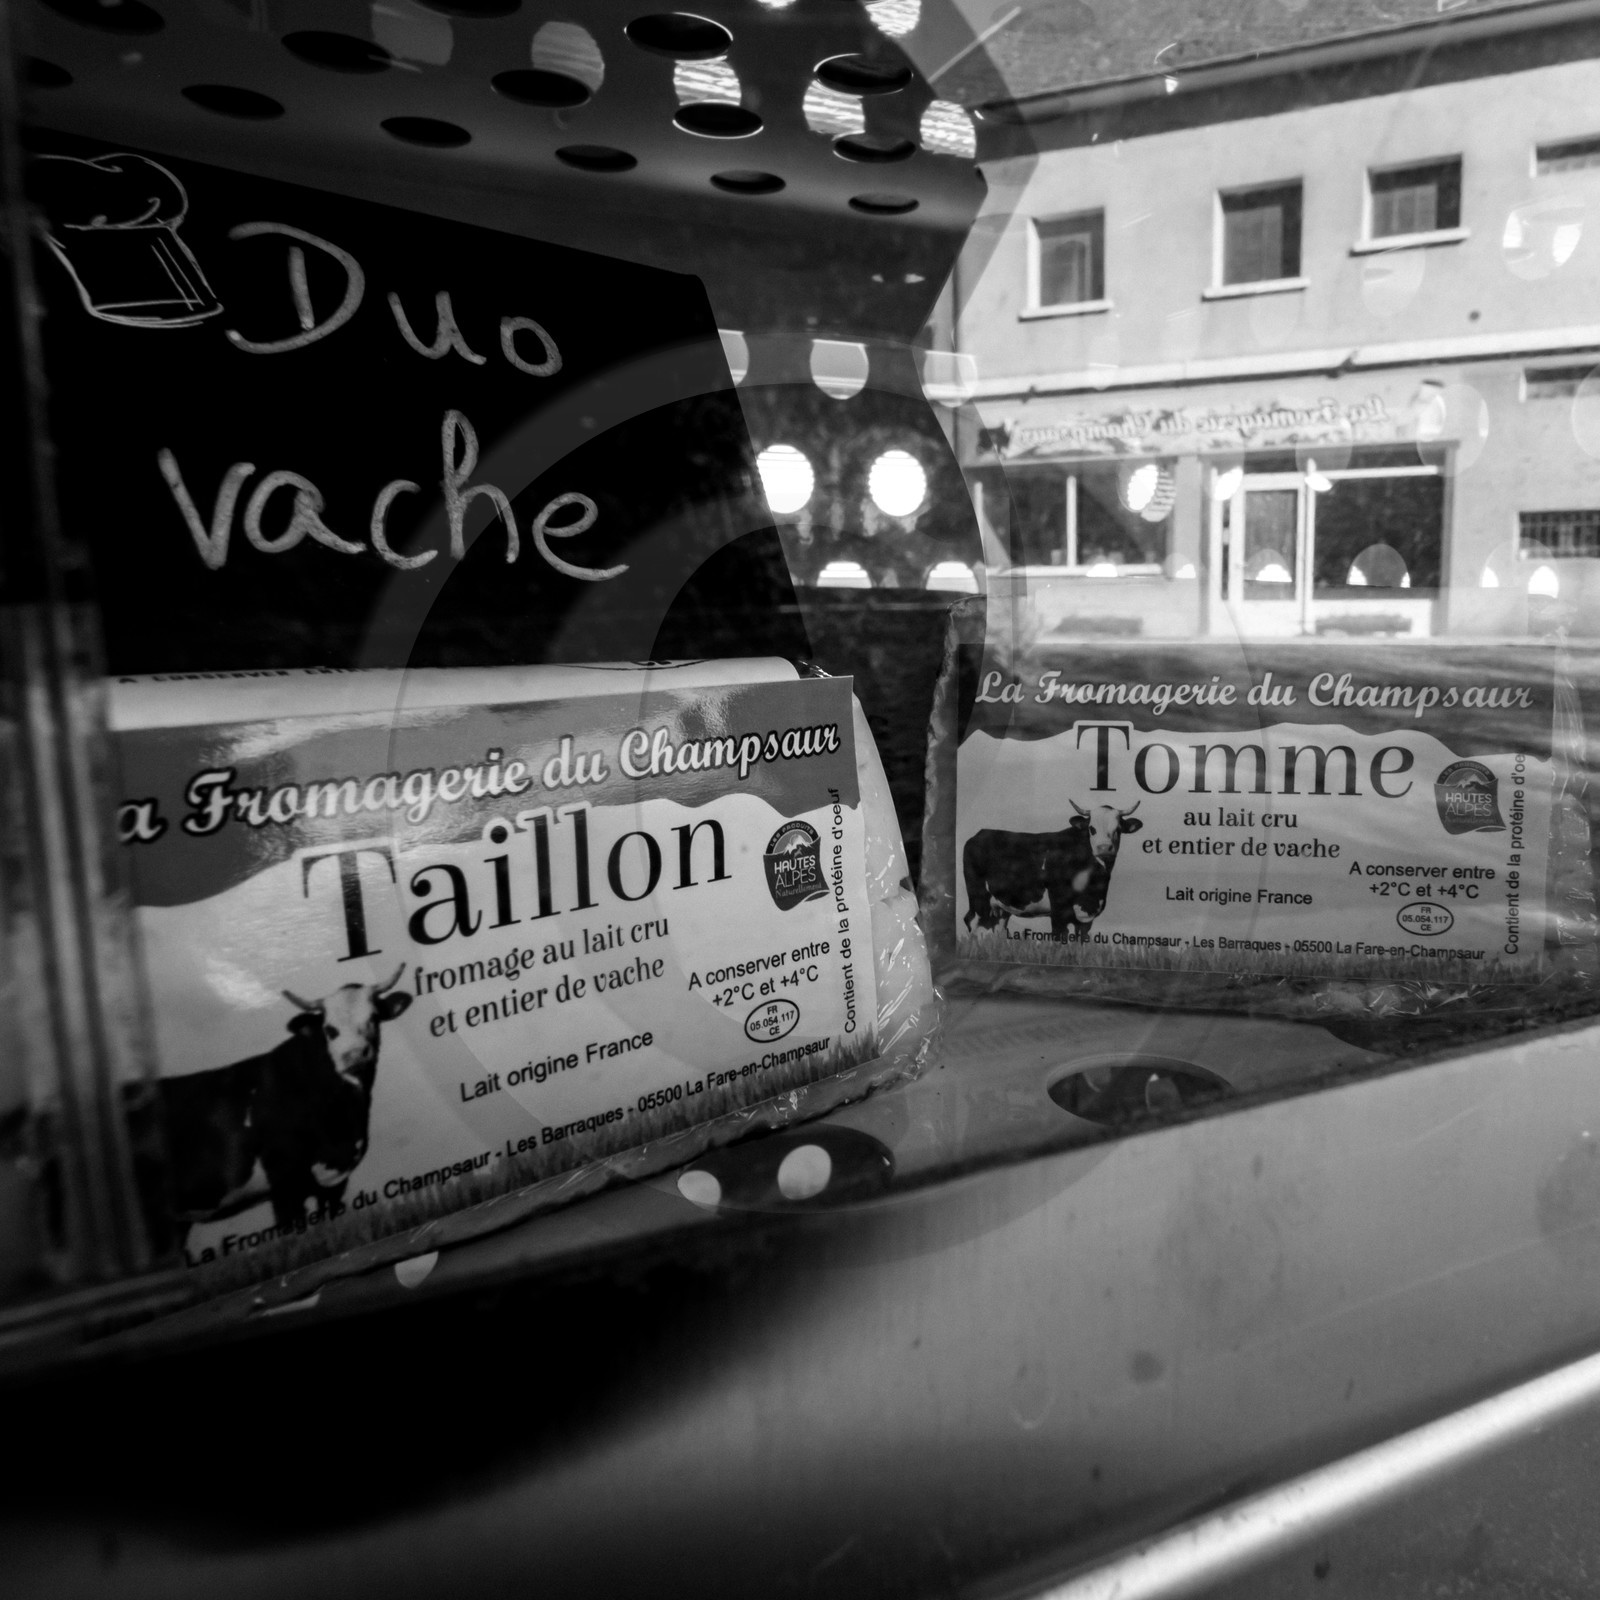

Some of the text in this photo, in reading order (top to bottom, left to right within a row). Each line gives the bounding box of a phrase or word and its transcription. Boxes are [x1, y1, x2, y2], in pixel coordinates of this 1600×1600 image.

[226, 221, 562, 377] Duo
[158, 409, 629, 580] vache
[975, 670, 1535, 718] La Fromagerie du Champsaur
[1076, 725, 1414, 798] Tomme
[117, 724, 840, 846] a Fromagerie du Champsaur
[1445, 792, 1492, 803] HAUTES
[1183, 807, 1298, 828] au lait cru
[1445, 803, 1492, 817] ALPES
[1509, 789, 1525, 849] protéine
[1142, 837, 1340, 858] et entier de vache
[1507, 853, 1520, 866] la
[774, 855, 816, 874] HAUTES
[775, 866, 816, 889] ALPES
[1349, 861, 1495, 879] A conserver entre
[1505, 870, 1519, 889] de
[302, 808, 733, 961] Taillon
[1166, 886, 1313, 905] Lait origine France
[1369, 881, 1479, 899] +2°C et +4°C
[828, 788, 856, 1033] Contient de la protéine d'oeuf
[1402, 915, 1449, 924] 05.054.117
[1504, 893, 1519, 955] Contient
[414, 918, 670, 996] fromage au lait cru
[1007, 928, 1020, 940] La
[1094, 932, 1108, 945] du
[1112, 933, 1181, 948] Champsaur
[1193, 936, 1214, 948] Les
[1219, 937, 1281, 953] Barraques
[1293, 940, 1331, 953] 05500
[1336, 942, 1351, 954] La
[1356, 942, 1485, 961] Fare-en-Champsaur
[688, 941, 830, 992] A conserver entre
[430, 955, 664, 1037] et entier de vache
[712, 964, 819, 1008] +2°C et +4°C
[750, 1010, 794, 1032] 05.054.117
[767, 1005, 779, 1015] FR
[769, 1024, 780, 1037] CE
[461, 1031, 653, 1102] Lait origine France
[184, 1247, 215, 1268] La
[353, 1191, 377, 1210] du
[383, 1150, 490, 1199] Champsaur
[506, 1136, 536, 1157] Les
[541, 1107, 624, 1144] Barraques
[638, 1084, 682, 1113] 05500
[686, 1078, 703, 1097] La
[707, 1036, 831, 1088] Fare-en-Champsaur
